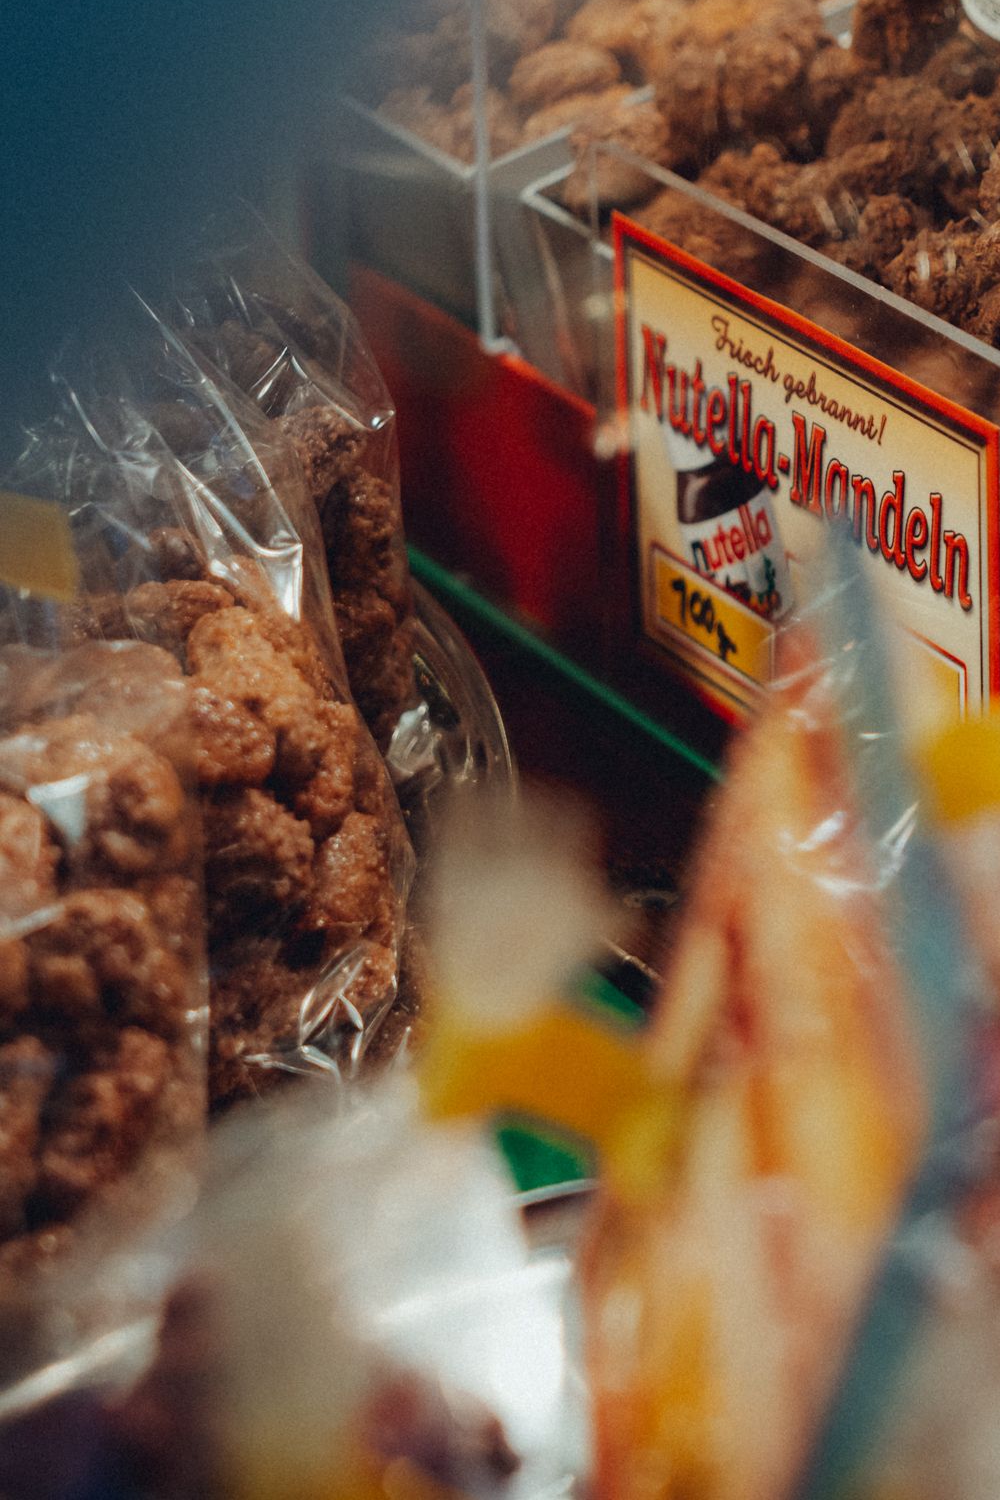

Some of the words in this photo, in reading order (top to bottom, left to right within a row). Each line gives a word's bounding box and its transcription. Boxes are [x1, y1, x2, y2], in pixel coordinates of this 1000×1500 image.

[640, 324, 972, 612] Nutella-Mandeln
[711, 315, 780, 382] Frisch
[783, 371, 887, 445] gebrannt!
